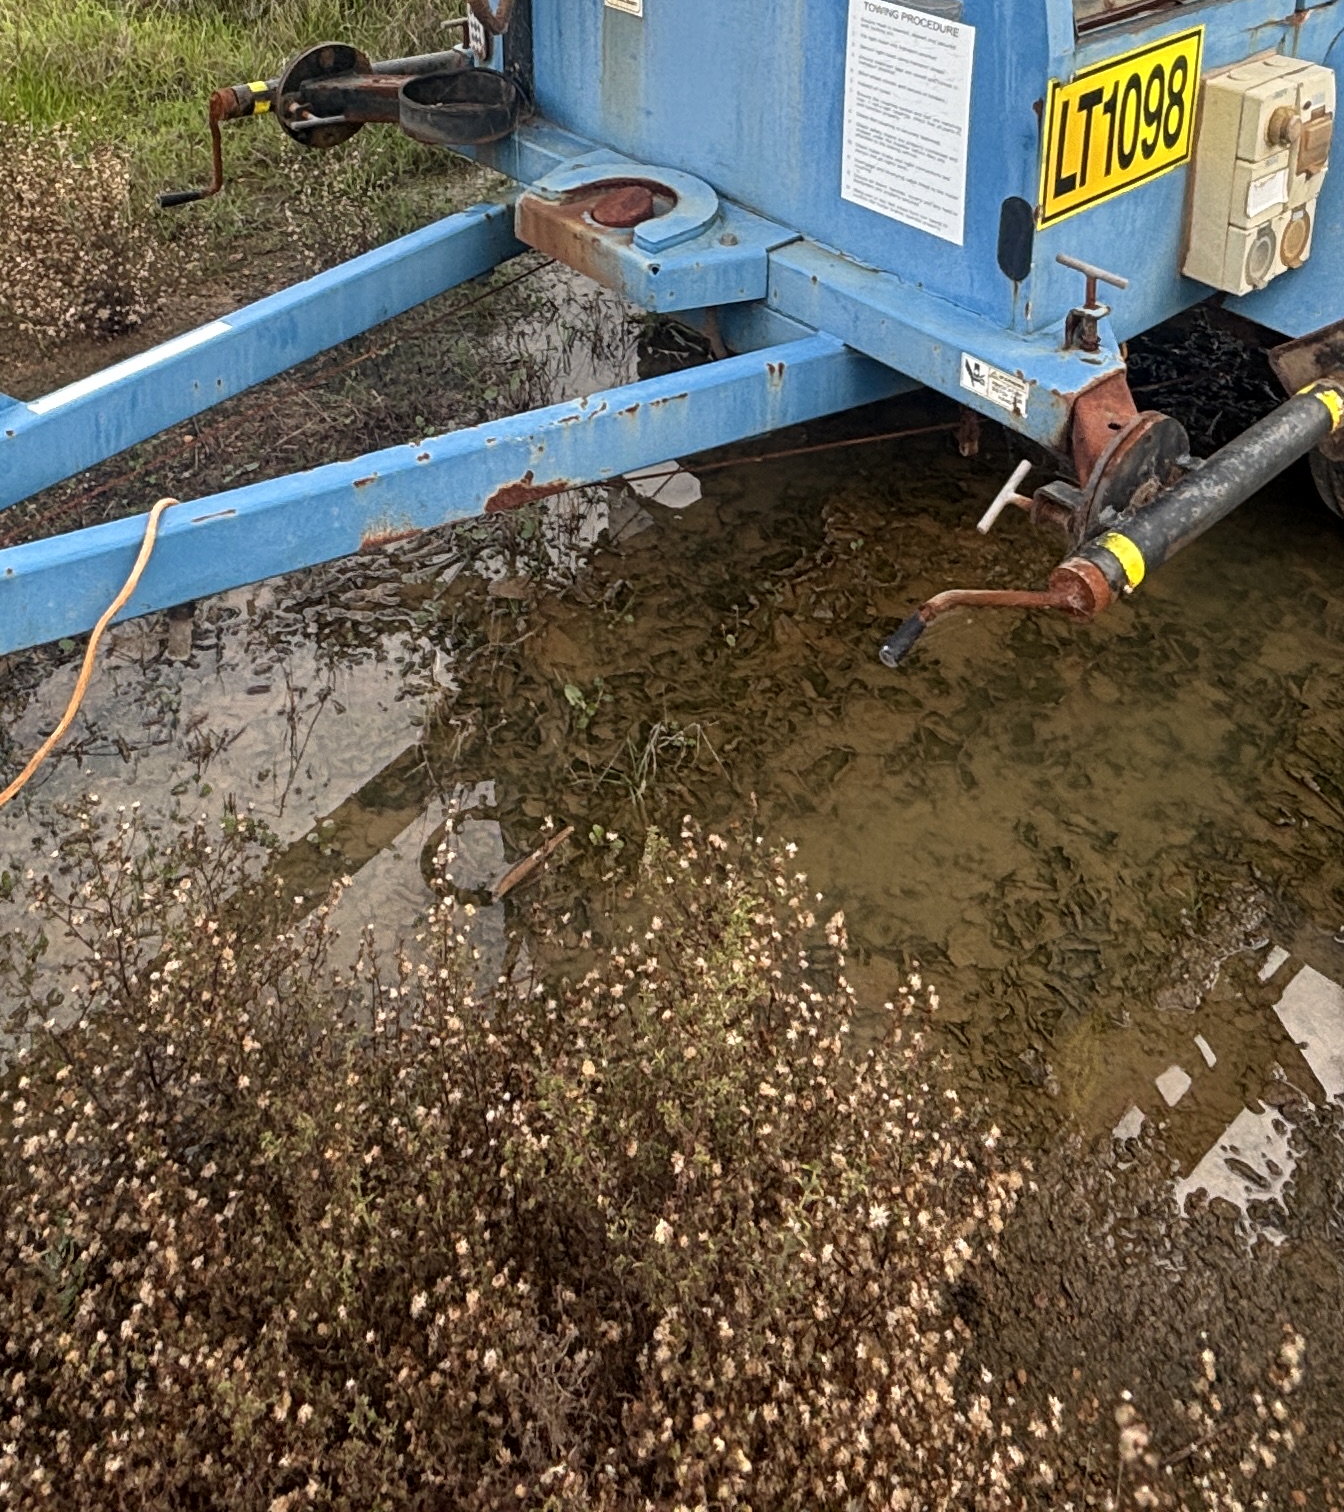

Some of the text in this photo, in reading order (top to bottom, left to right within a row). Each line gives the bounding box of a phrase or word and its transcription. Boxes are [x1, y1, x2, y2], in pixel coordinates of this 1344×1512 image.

[864, 1, 960, 38] TOWING PROCEDURE
[1053, 54, 1188, 199] LT1098
